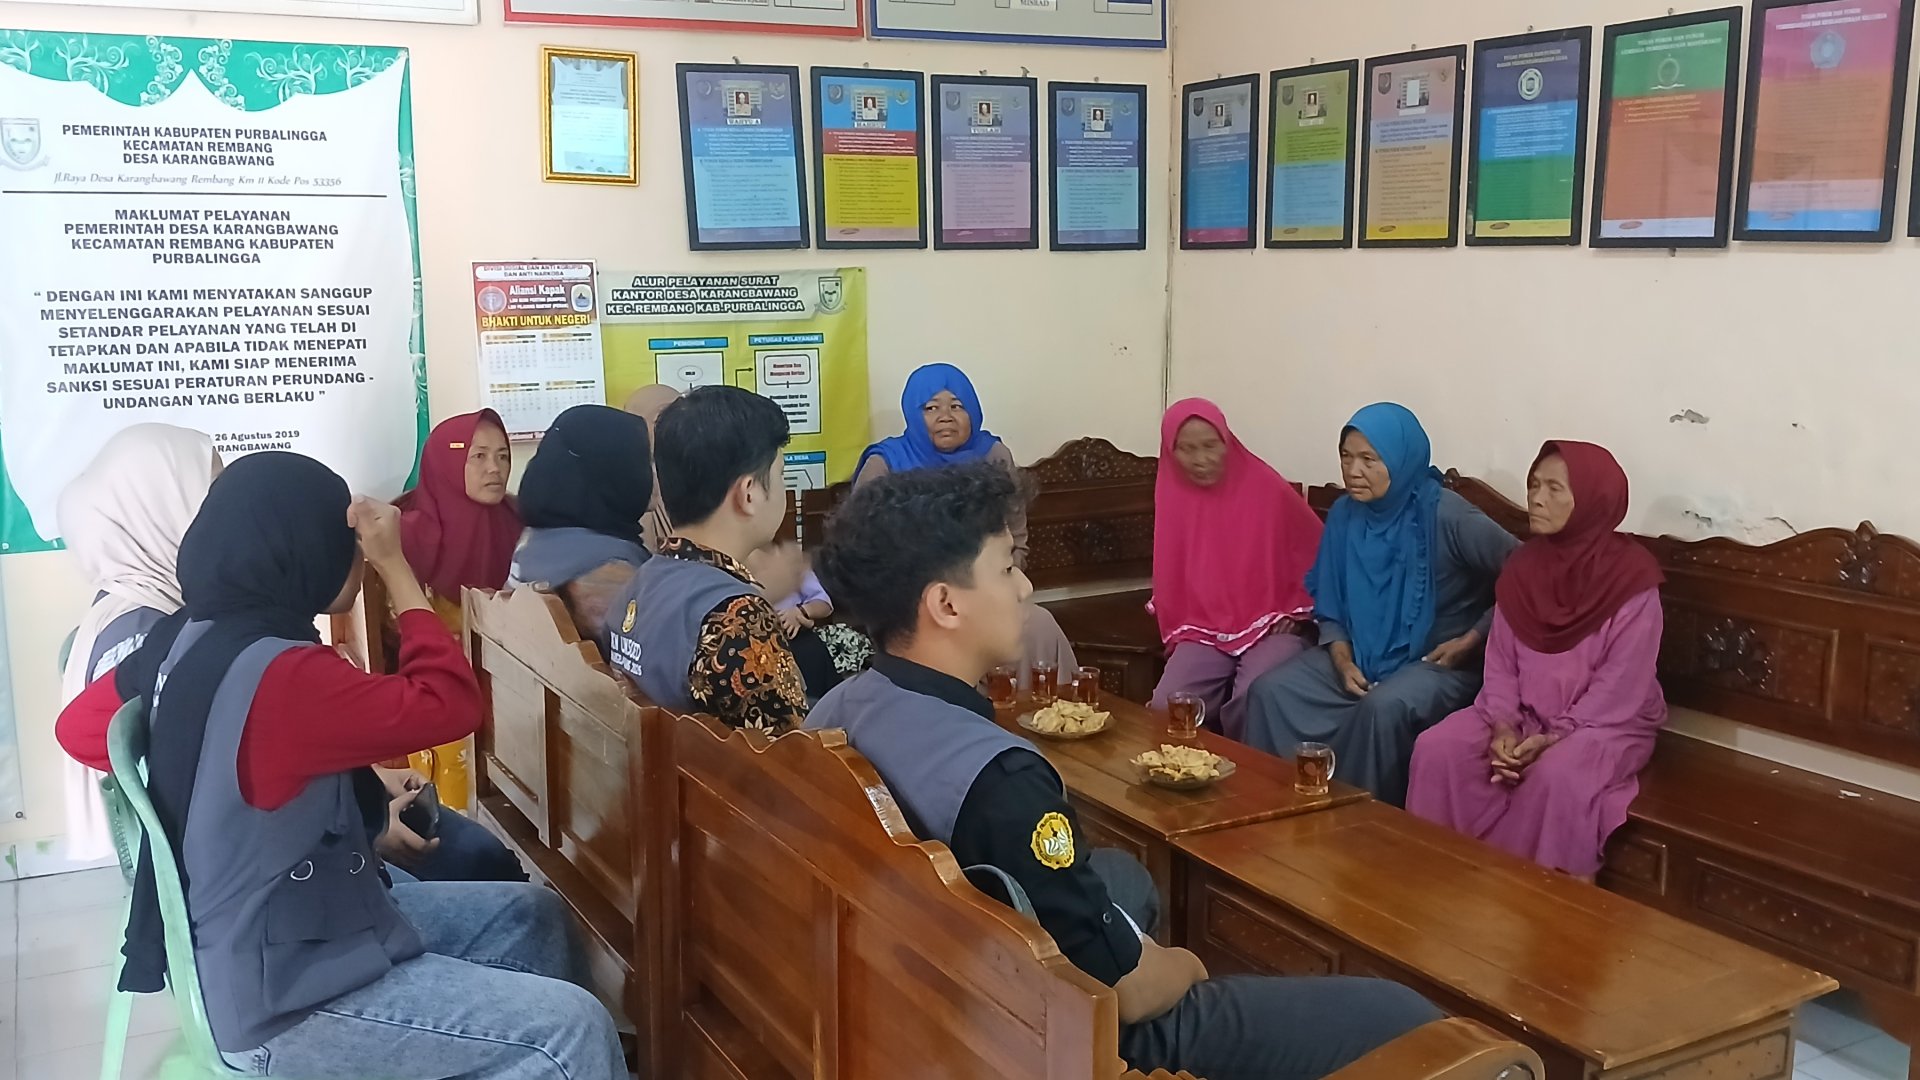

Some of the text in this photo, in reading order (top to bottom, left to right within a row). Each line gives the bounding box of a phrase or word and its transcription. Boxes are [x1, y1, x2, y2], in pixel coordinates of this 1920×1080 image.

[63, 125, 327, 141] PEMERINTAH KABUPATEN PURBALINGGA
[123, 140, 272, 153] KECAMATAN REMBANG
[123, 153, 274, 166] DESA KARANGBAWANG
[90, 173, 114, 183] Desa
[117, 173, 188, 186] Karangbawang
[191, 174, 235, 186] Rembang
[238, 175, 254, 184] Km
[267, 175, 290, 185] Kode
[294, 176, 309, 185] Pos
[312, 177, 342, 187] 53356
[115, 210, 290, 221] MAKLUMAT PELAYANAN
[65, 224, 338, 235] PEMERINTAH DESA KARANGBAWANG
[72, 239, 333, 249] KECAMATAN REMBANG KABUPATEN
[153, 253, 260, 264] PURBALINGGA
[632, 275, 779, 288] ALUR PELAYANAN SURAT
[47, 290, 115, 302] DENGAN
[120, 290, 142, 301] INI
[147, 289, 188, 300] KAMI
[193, 288, 295, 300] MENYATAKAN
[301, 288, 372, 299] SANGGUP
[509, 284, 565, 297] Aliansi Kapak
[612, 287, 799, 301] KANTOR DESA KARANGBAWANG
[41, 305, 369, 320] MENYELENGGARAKAN PELAYANAN SESUAI
[606, 300, 805, 315] KEC.REMBANG KAB.PURBALINGGA
[482, 314, 591, 327] BHAKTI UNTUK NEGERI
[59, 322, 356, 338] SETANDAR PELAYANAN YANG TELAH DI
[48, 339, 366, 356] TETAPKAN DAN APABILA TIDAK MENEPATI
[64, 356, 356, 374] MAKLUMAT INI, KAMI SIAP MENERIMA
[47, 380, 107, 393] SANKSI
[112, 378, 169, 391] SESUAI
[175, 375, 267, 389] PERATURAN
[273, 372, 365, 385] PERUNDANG
[103, 395, 192, 409] UNDANGAN
[197, 394, 239, 405] YANG
[244, 391, 314, 403] BERLAKU
[215, 430, 300, 442] 26 Agustus 2019
